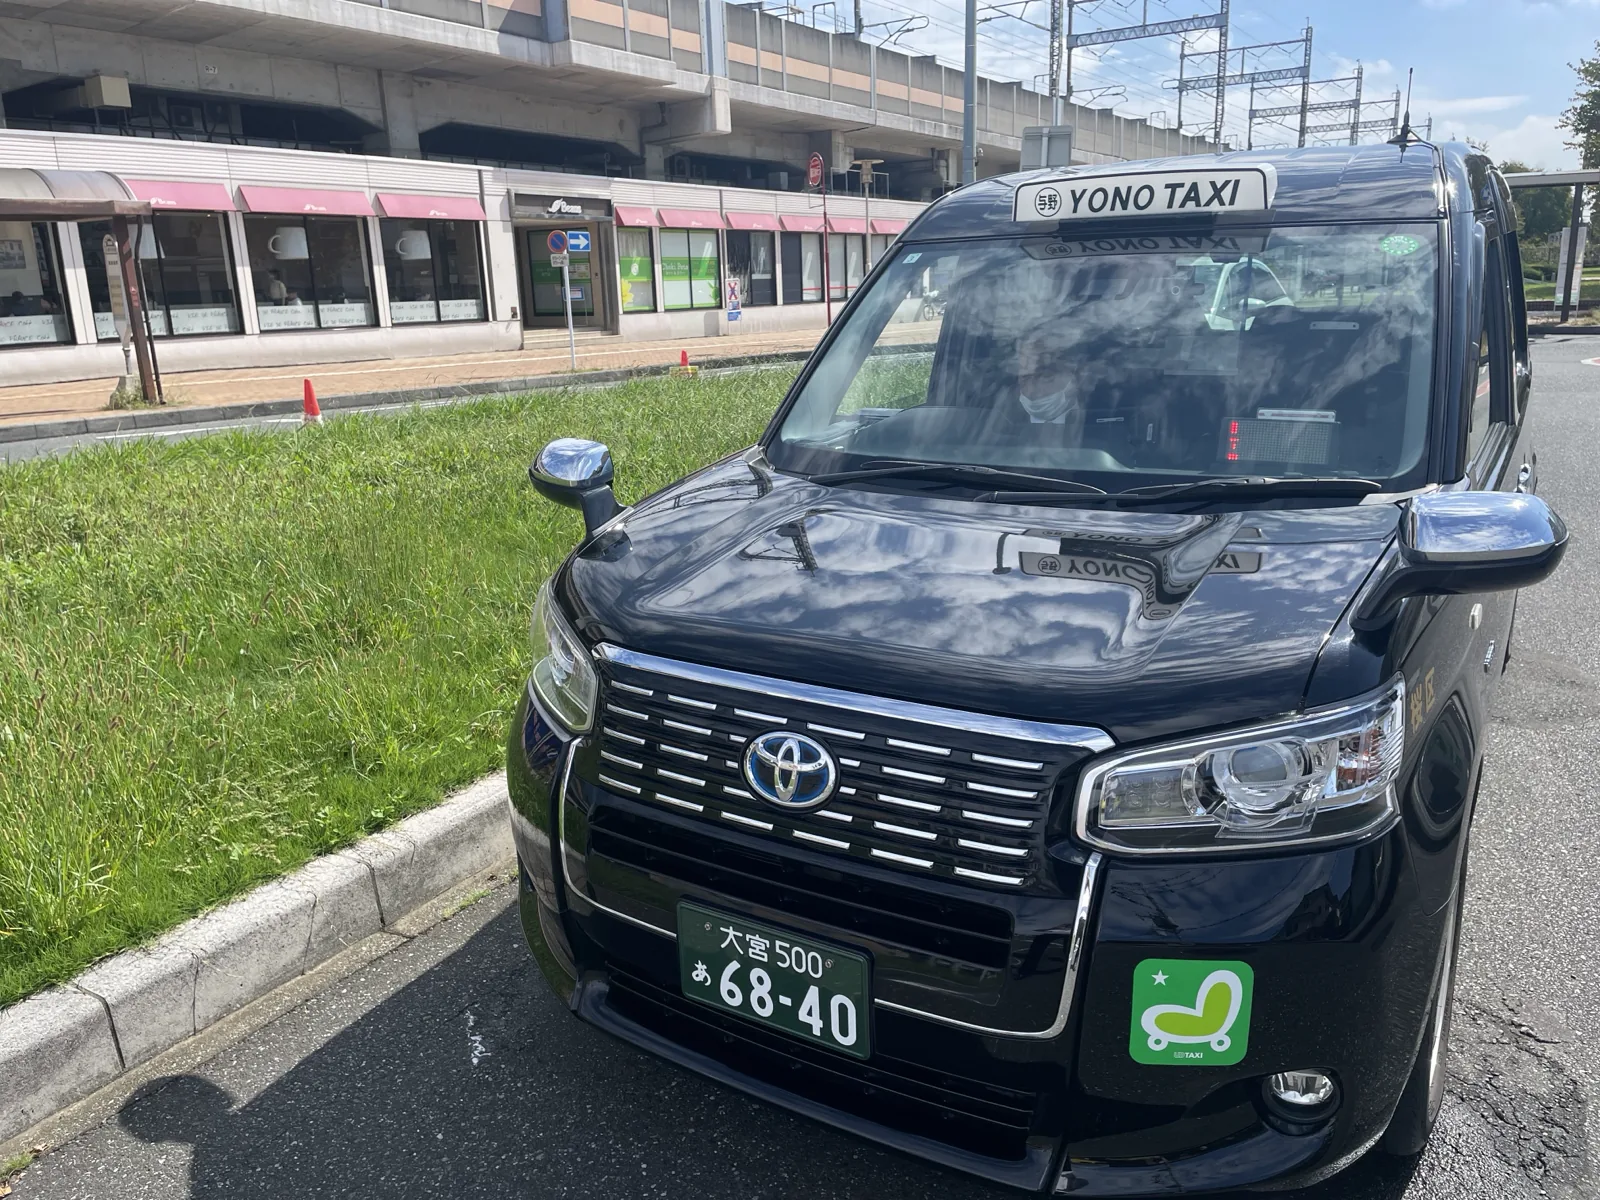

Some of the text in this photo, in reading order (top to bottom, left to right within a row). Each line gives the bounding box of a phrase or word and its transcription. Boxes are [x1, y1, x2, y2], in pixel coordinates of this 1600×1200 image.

[1037, 192, 1059, 213] 与野
[1070, 179, 1241, 213] YONO TAXI
[720, 926, 823, 978] 大宮 500
[692, 960, 857, 1046] あ 68-40
